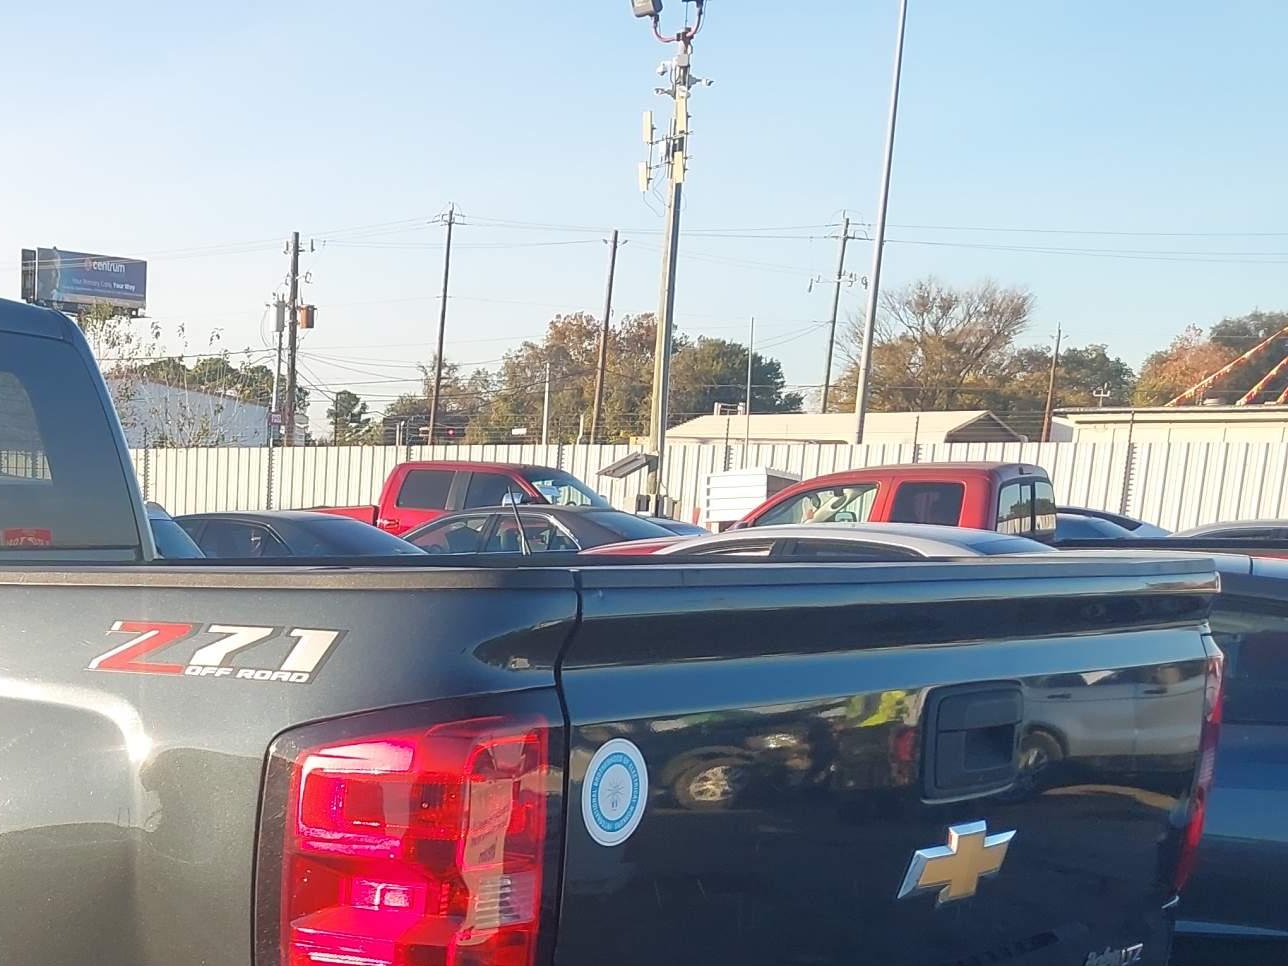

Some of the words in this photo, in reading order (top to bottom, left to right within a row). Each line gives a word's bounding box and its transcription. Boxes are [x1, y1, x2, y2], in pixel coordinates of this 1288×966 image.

[92, 261, 126, 273] centrum
[86, 620, 347, 676] Z71
[185, 665, 233, 677] OFF
[236, 668, 310, 683] ROAD
